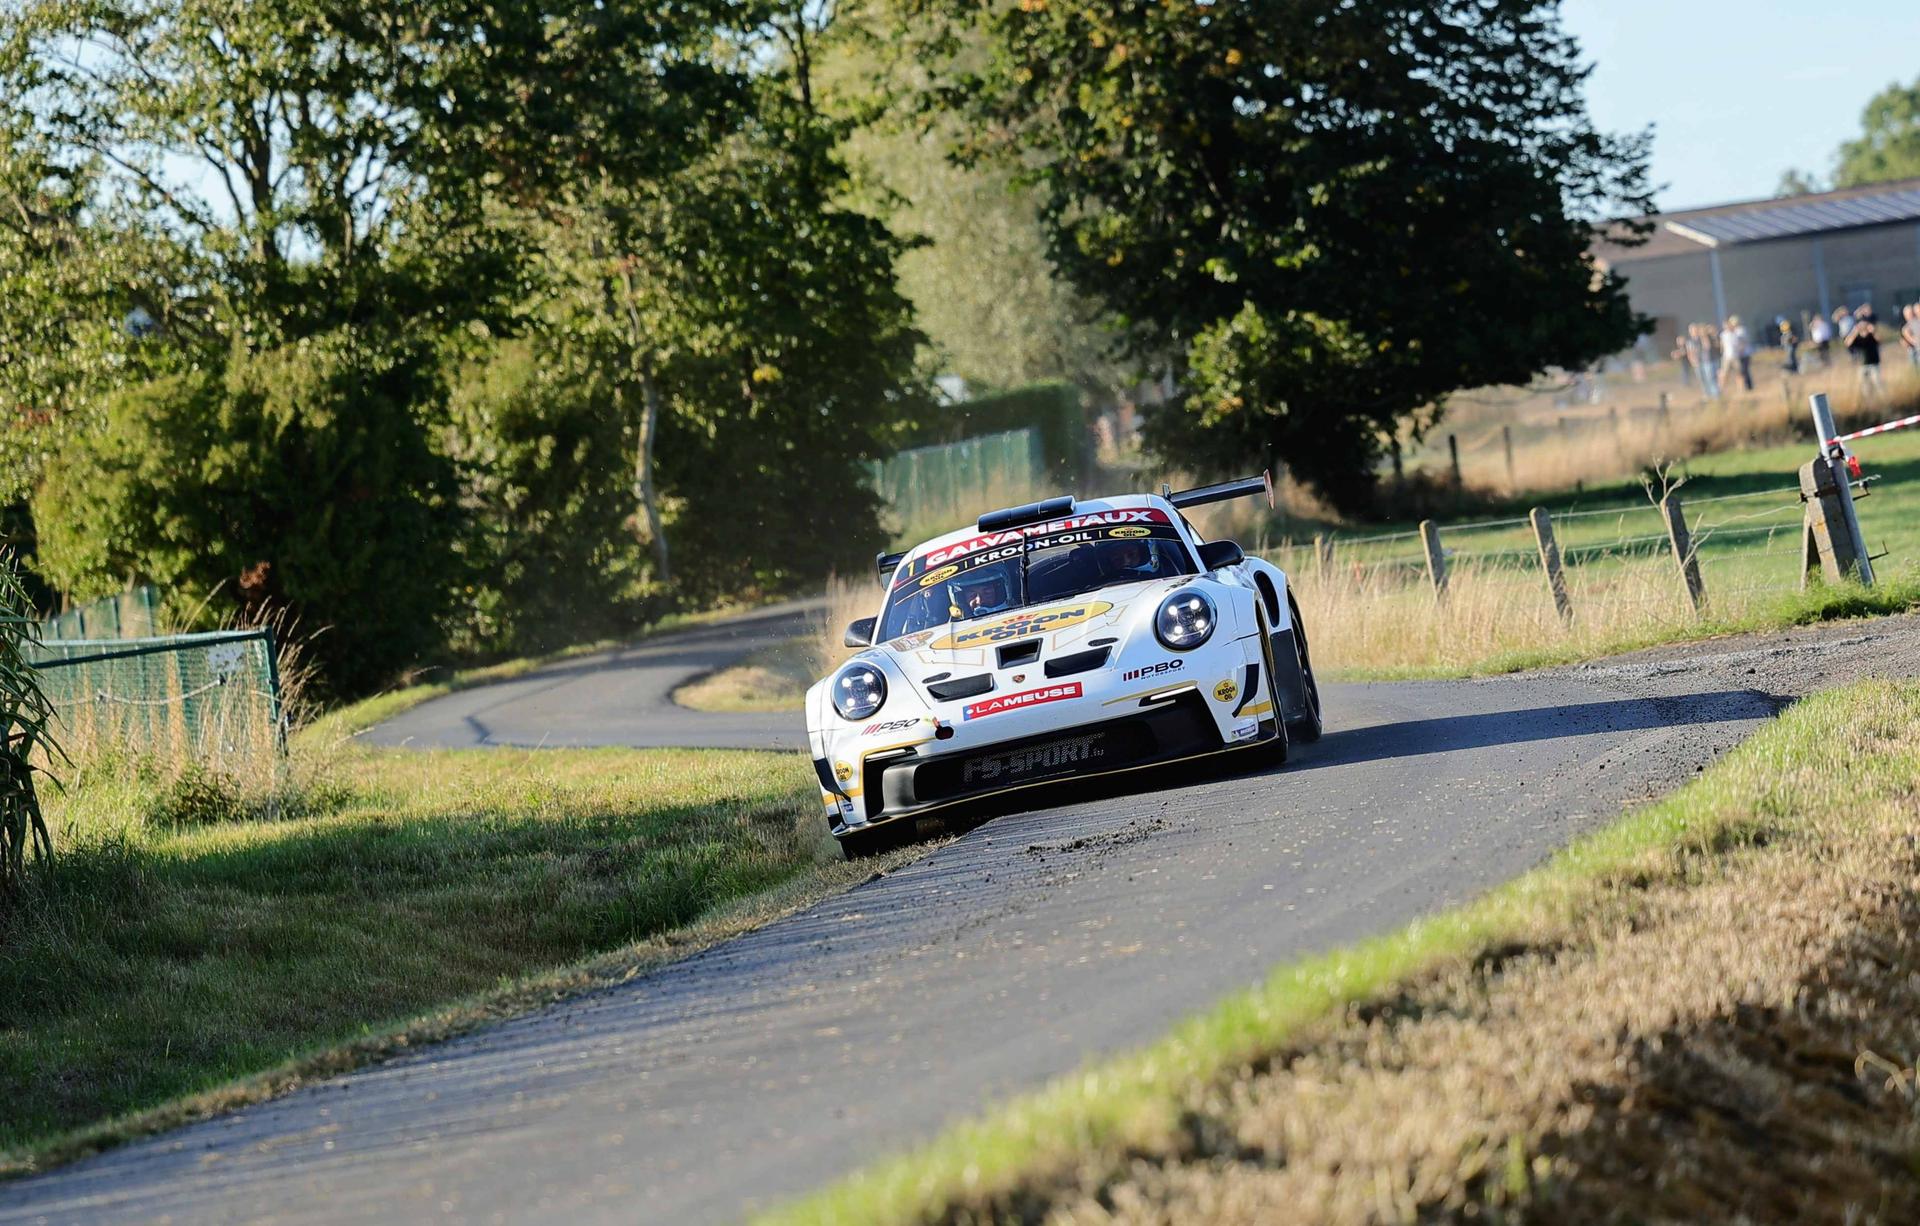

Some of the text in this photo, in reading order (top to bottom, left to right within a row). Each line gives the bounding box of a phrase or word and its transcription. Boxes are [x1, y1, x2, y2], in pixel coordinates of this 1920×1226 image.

[907, 561, 915, 577] 1
[956, 608, 1086, 643] KROON
[990, 624, 1046, 641] OIL
[1140, 659, 1183, 677] PBO
